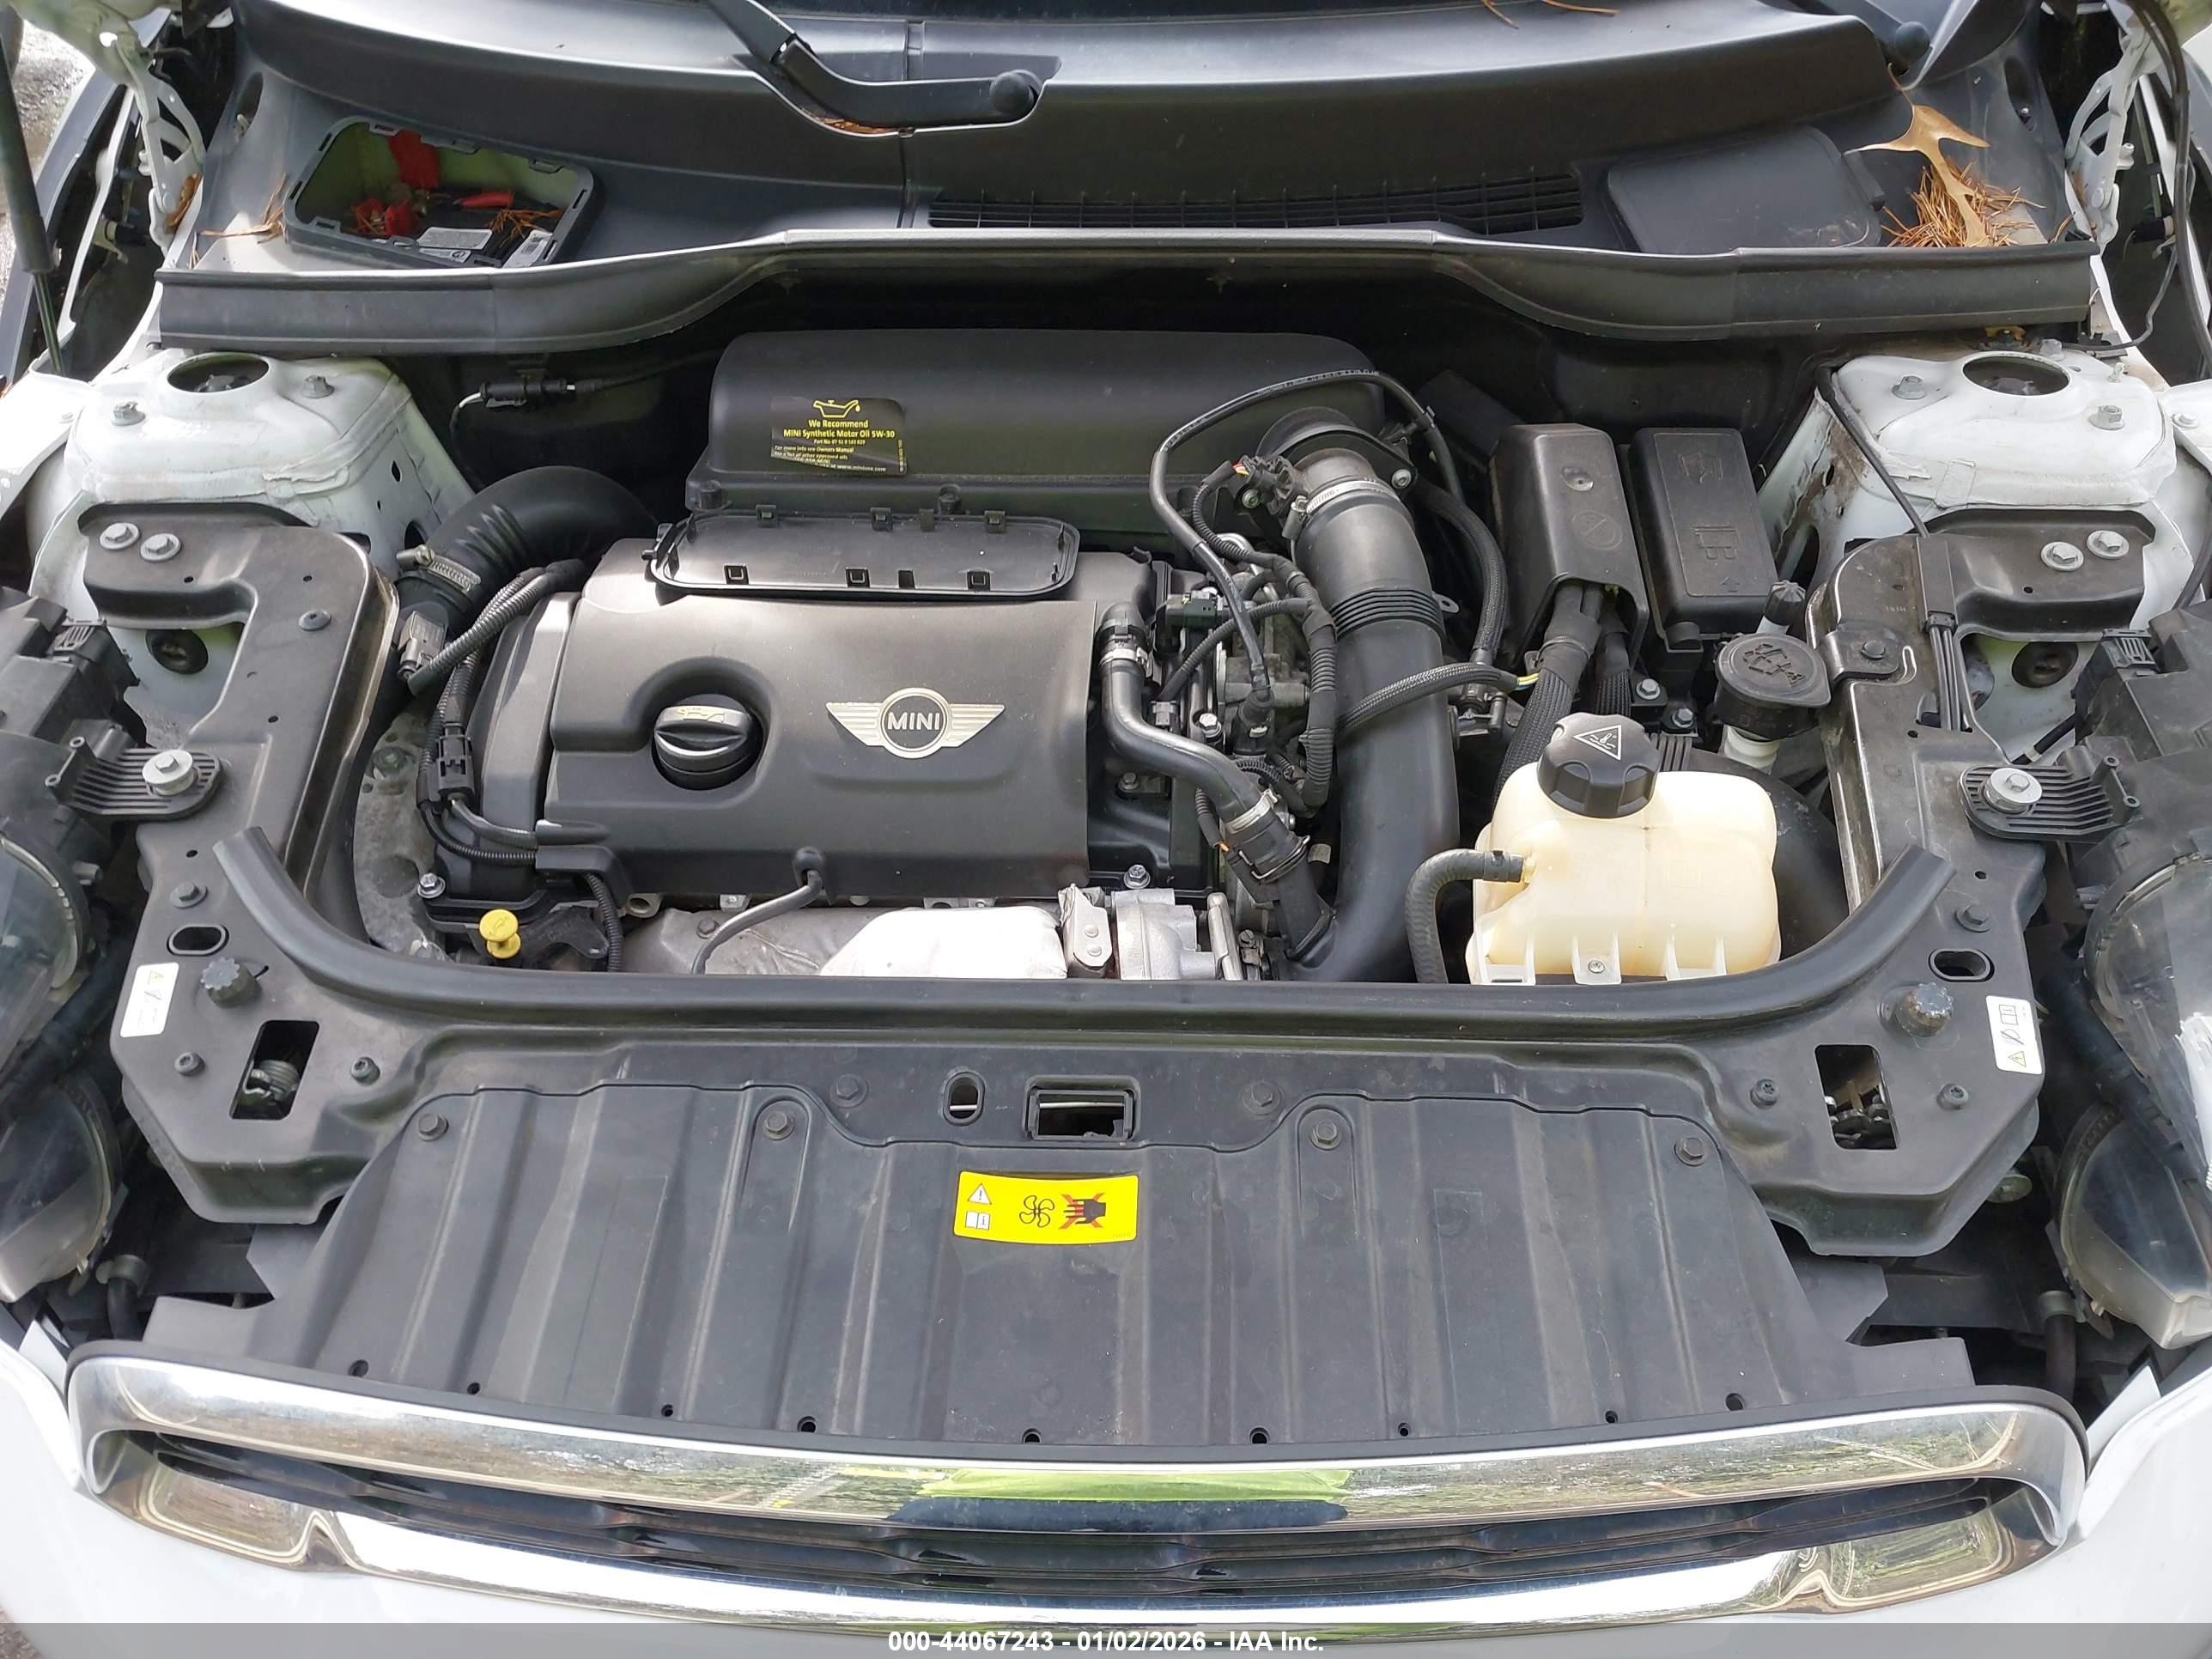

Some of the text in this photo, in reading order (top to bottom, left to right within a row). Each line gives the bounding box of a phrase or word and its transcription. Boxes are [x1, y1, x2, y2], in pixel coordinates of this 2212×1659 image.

[823, 419, 869, 428] Recommend
[802, 430, 836, 440] Synthetic
[887, 712, 940, 730] MINI
